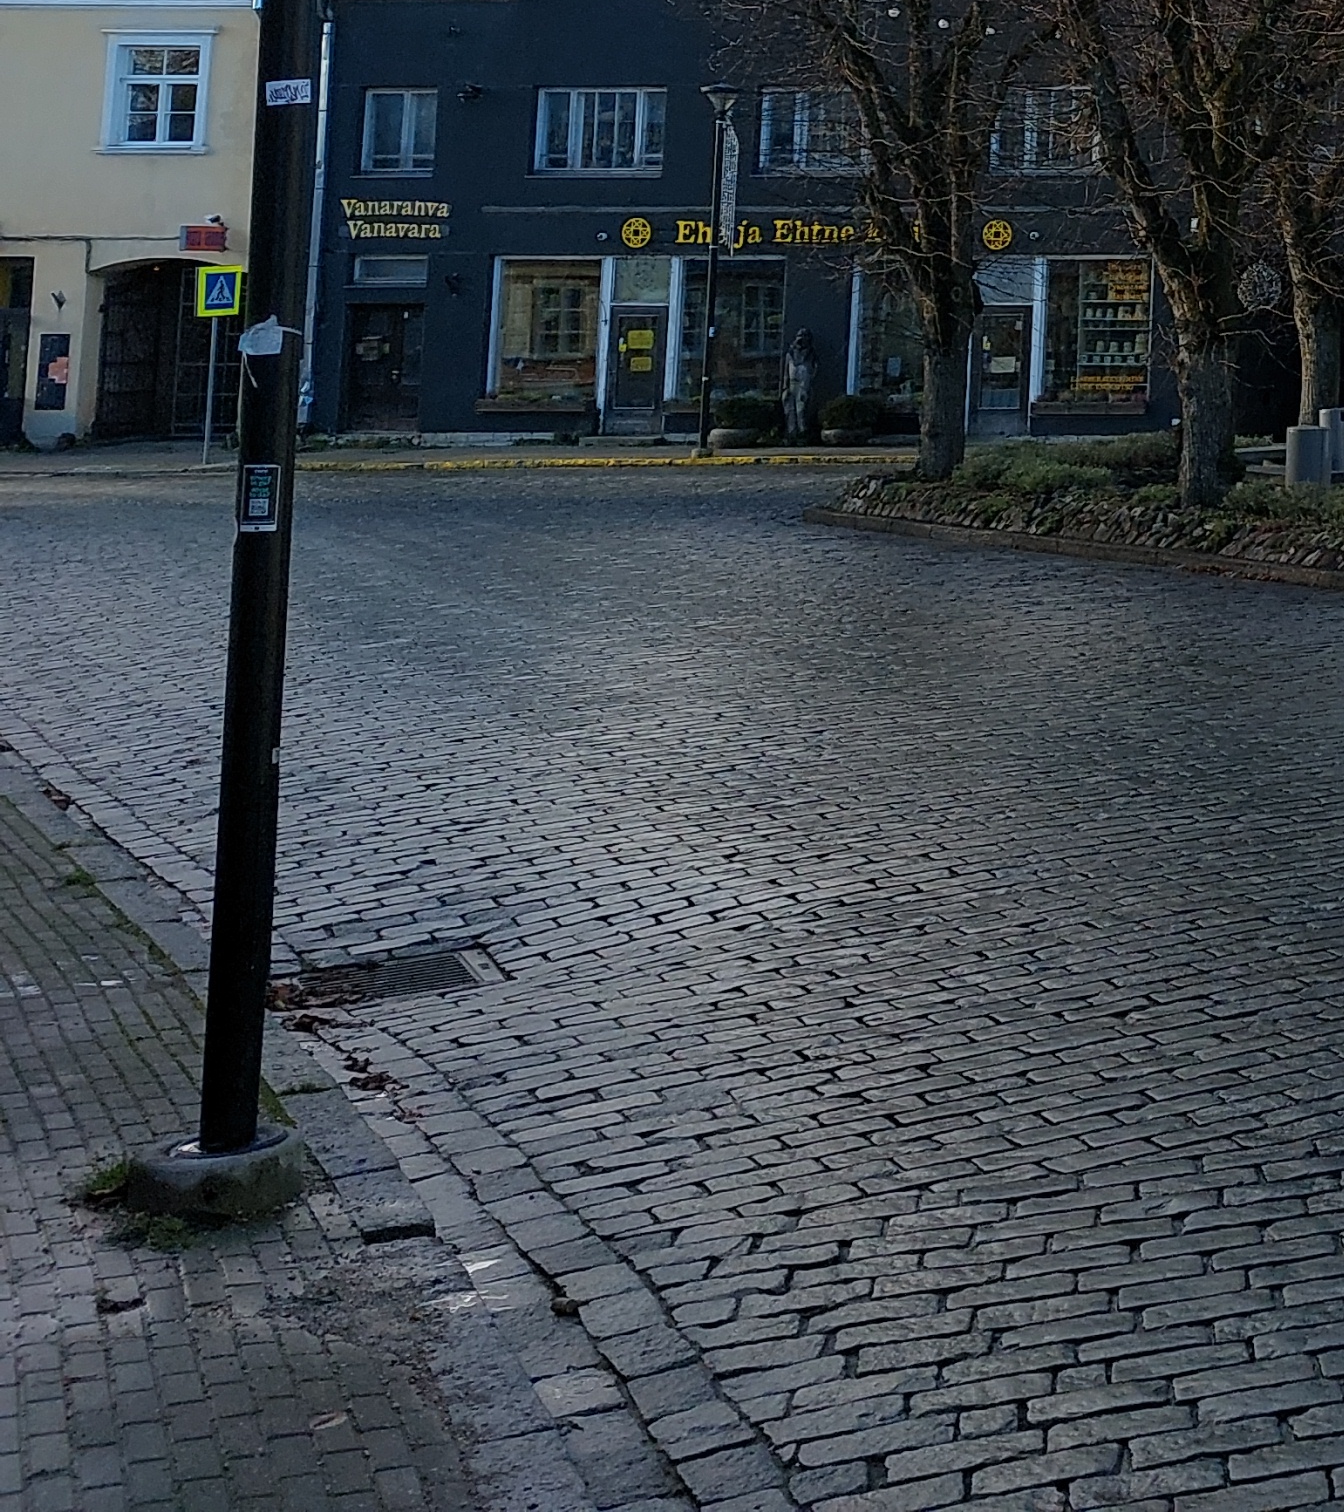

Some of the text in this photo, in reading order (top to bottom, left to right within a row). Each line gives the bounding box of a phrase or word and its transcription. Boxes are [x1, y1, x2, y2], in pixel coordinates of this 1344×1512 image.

[340, 199, 450, 218] Vanarahva
[346, 220, 441, 240] Vanavara
[733, 219, 763, 249] ja
[772, 219, 855, 244] Ehtne
